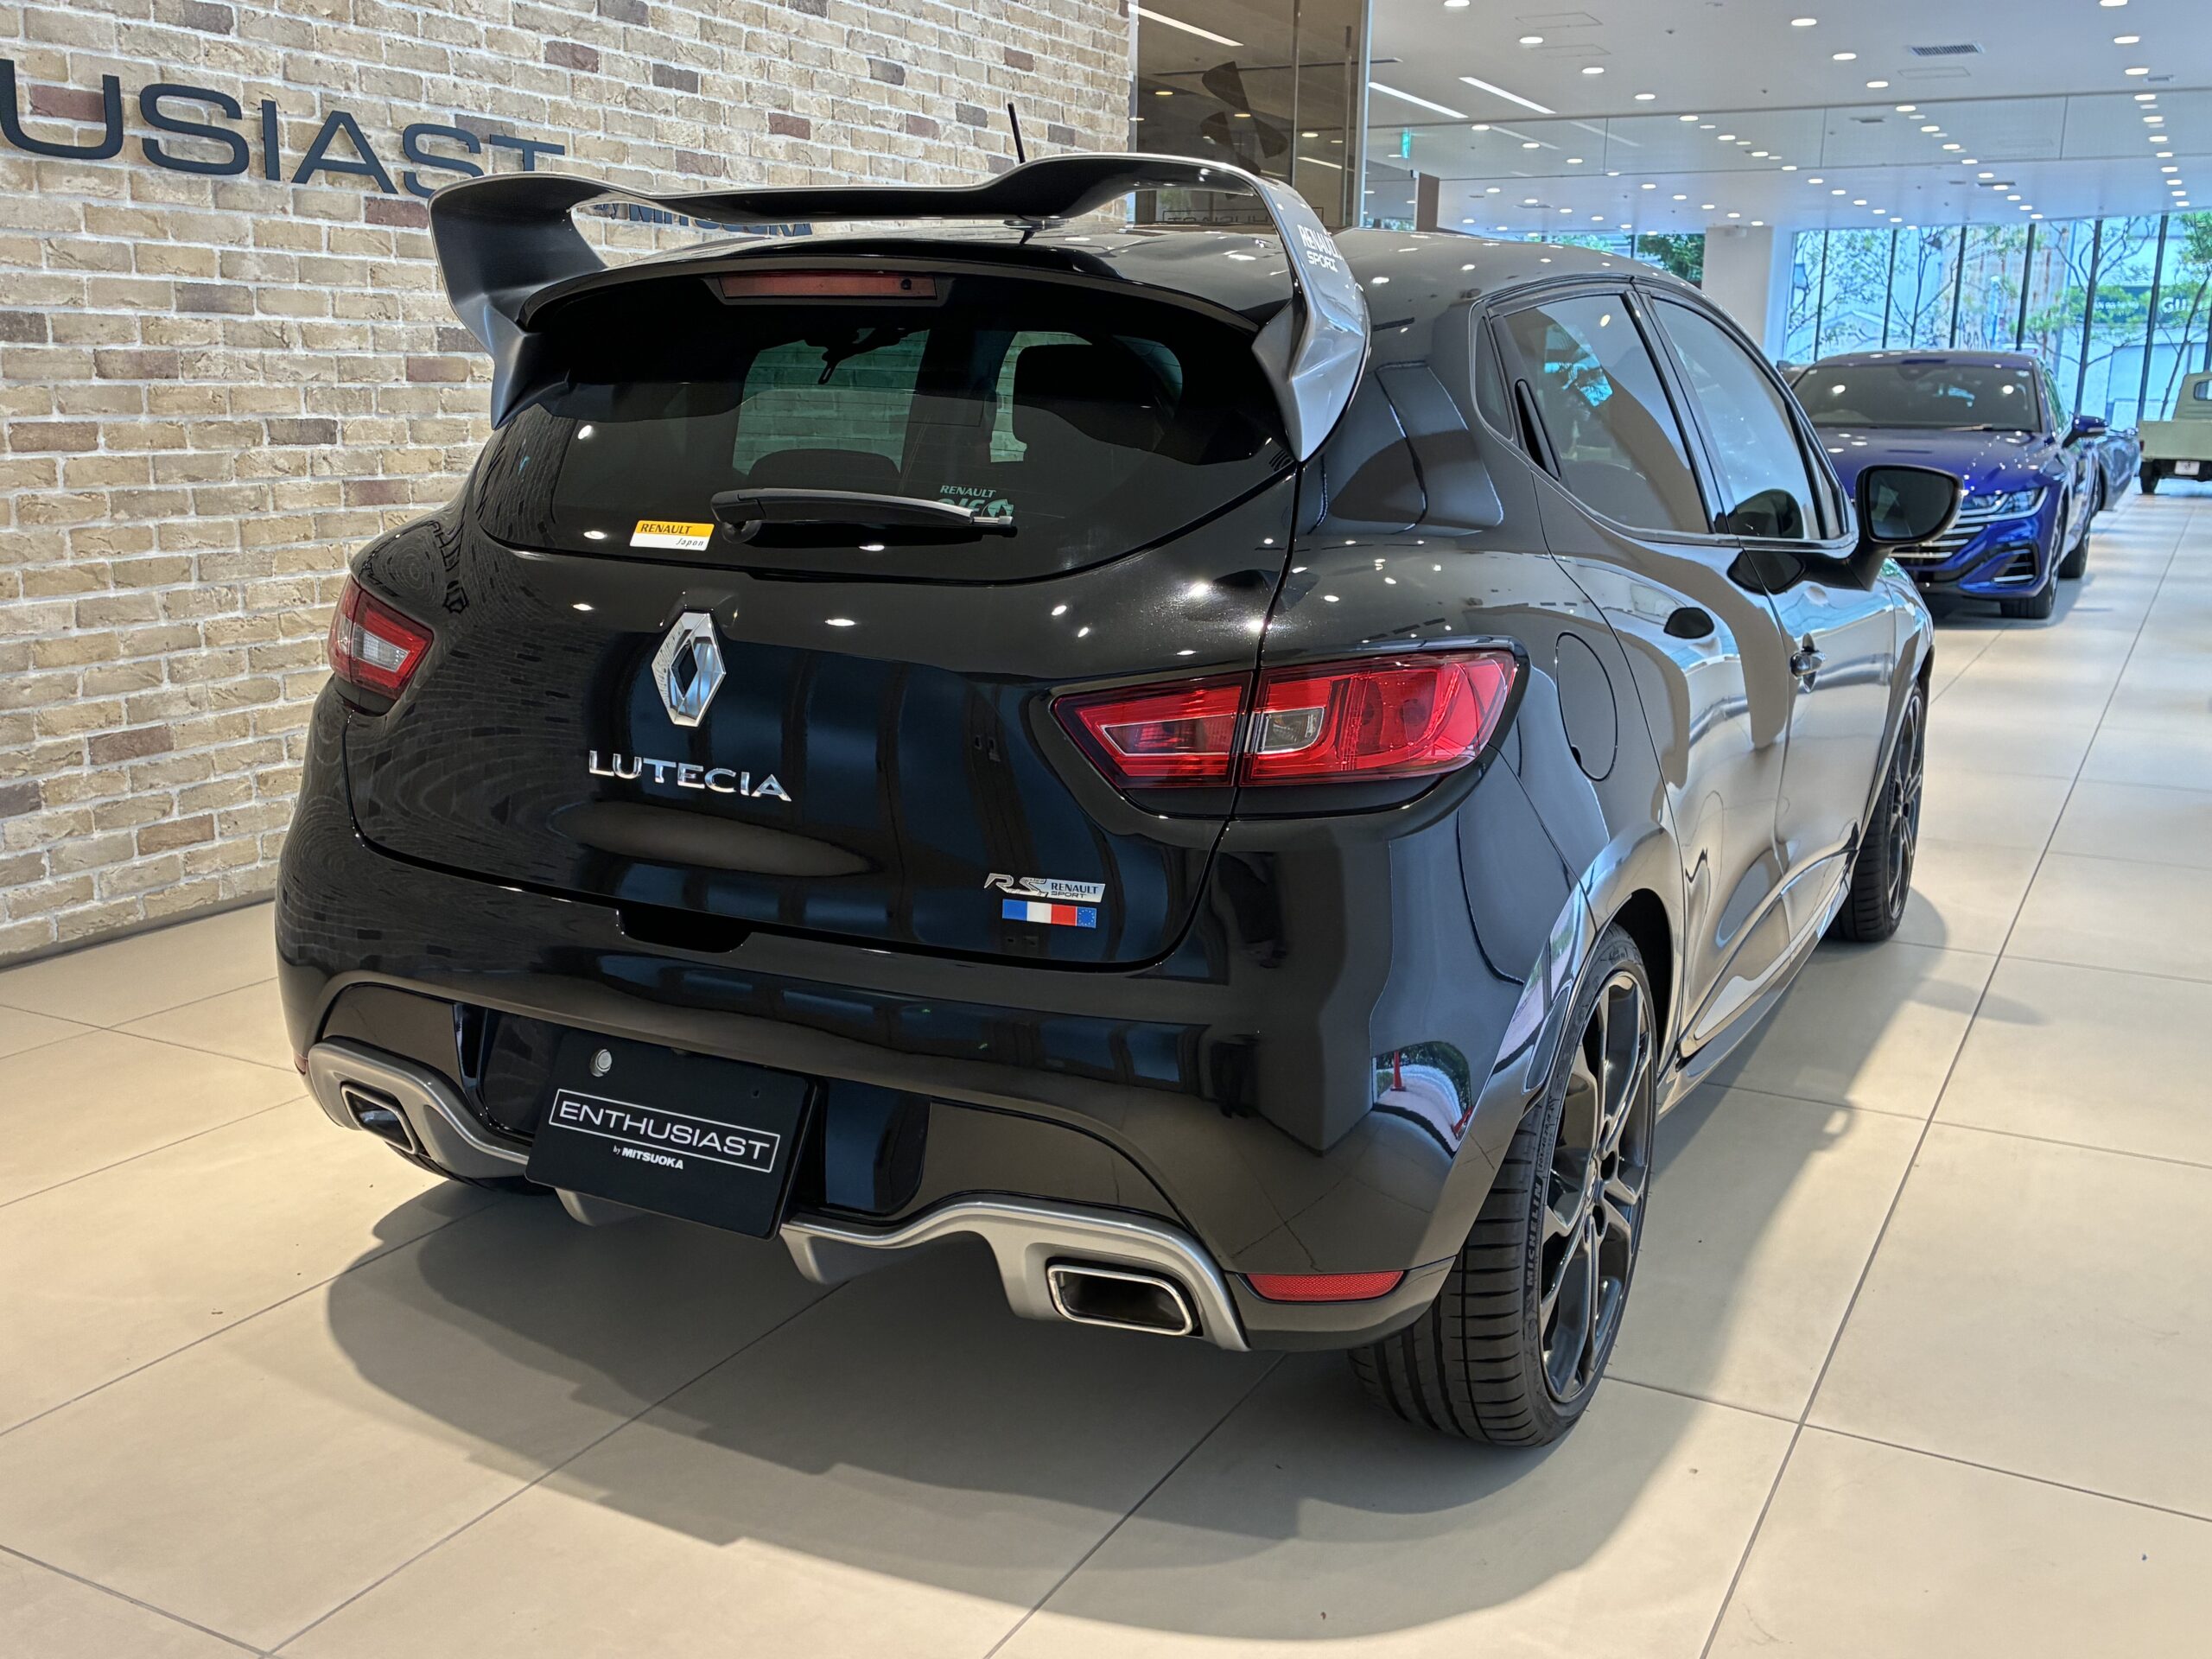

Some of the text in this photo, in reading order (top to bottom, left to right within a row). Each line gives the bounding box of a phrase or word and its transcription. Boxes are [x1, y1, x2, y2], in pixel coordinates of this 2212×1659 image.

[1306, 251, 1338, 272] SPORT
[940, 485, 996, 498] RENAULT
[640, 523, 692, 535] RENAULT
[589, 750, 791, 802] LUTECIA
[1051, 882, 1098, 894] RENAULT
[559, 1100, 770, 1160] ENTHUSIAST
[613, 1145, 683, 1170] by MITSUOKA
[1527, 1182, 1541, 1287] MICHELIN
